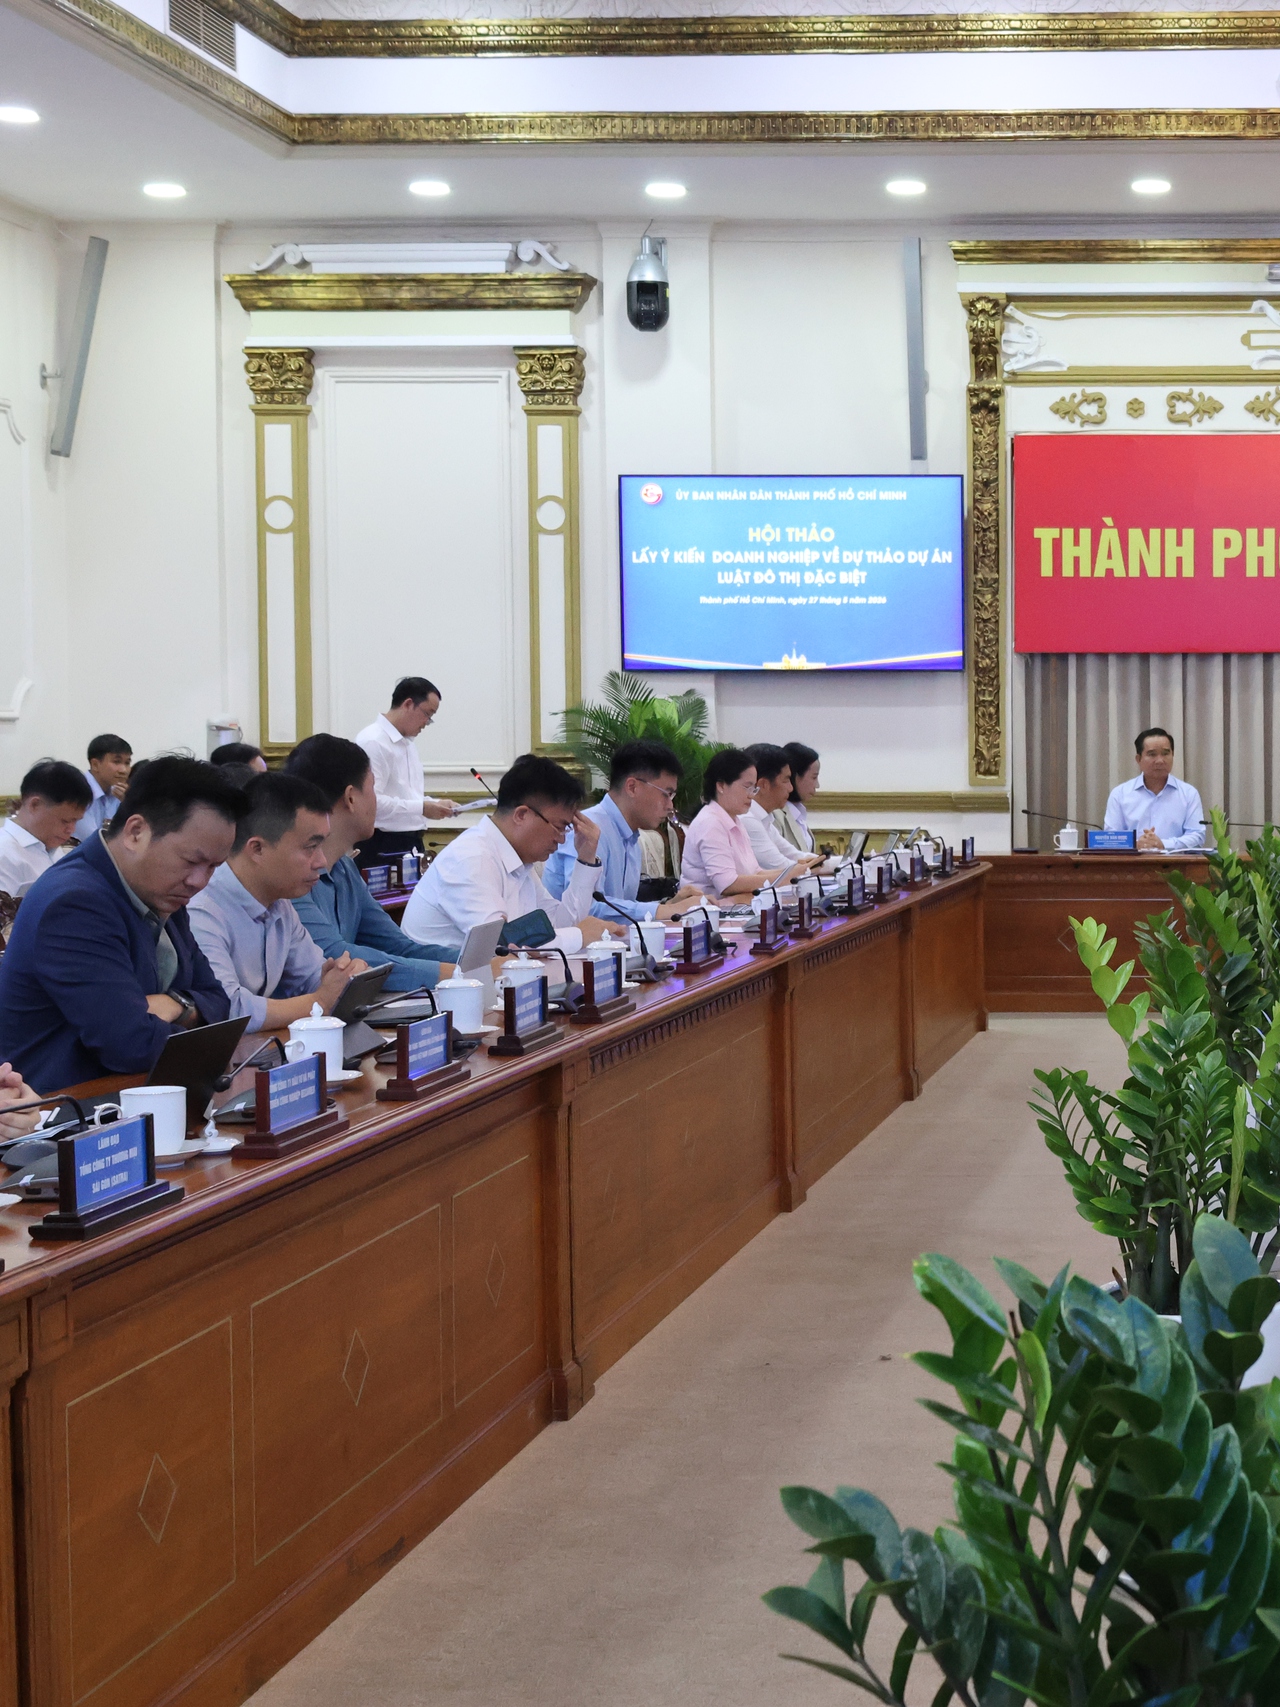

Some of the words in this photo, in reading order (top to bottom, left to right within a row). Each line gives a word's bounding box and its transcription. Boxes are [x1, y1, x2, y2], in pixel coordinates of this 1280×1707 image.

[675, 488, 689, 500] ỦY
[692, 491, 714, 500] BAN
[716, 488, 746, 500] NHÂN
[750, 488, 772, 500] DÂN
[775, 489, 810, 500] THÀNH
[813, 487, 836, 500] PHỐ
[839, 487, 855, 500] HỒ
[857, 489, 877, 500] CHÍ
[879, 491, 906, 500] MINH
[749, 523, 780, 546] HỘI
[786, 522, 835, 542] THẢO
[632, 546, 658, 563] LẤY
[661, 548, 670, 563] Ý
[674, 546, 705, 563] KIẾN
[712, 551, 764, 563] DOANH
[767, 548, 820, 566] NGHIỆP
[822, 546, 840, 563] VỀ
[843, 550, 863, 566] DỰ
[866, 547, 905, 563] THẢO
[908, 550, 928, 566] DỰ
[931, 548, 952, 563] ÁN
[1034, 517, 1194, 577] THÀNH
[717, 568, 751, 587] LUẬT
[753, 568, 775, 584] ĐÔ
[779, 572, 800, 587] THỊ
[804, 569, 836, 587] ĐẶC
[840, 568, 867, 587] BIỆT
